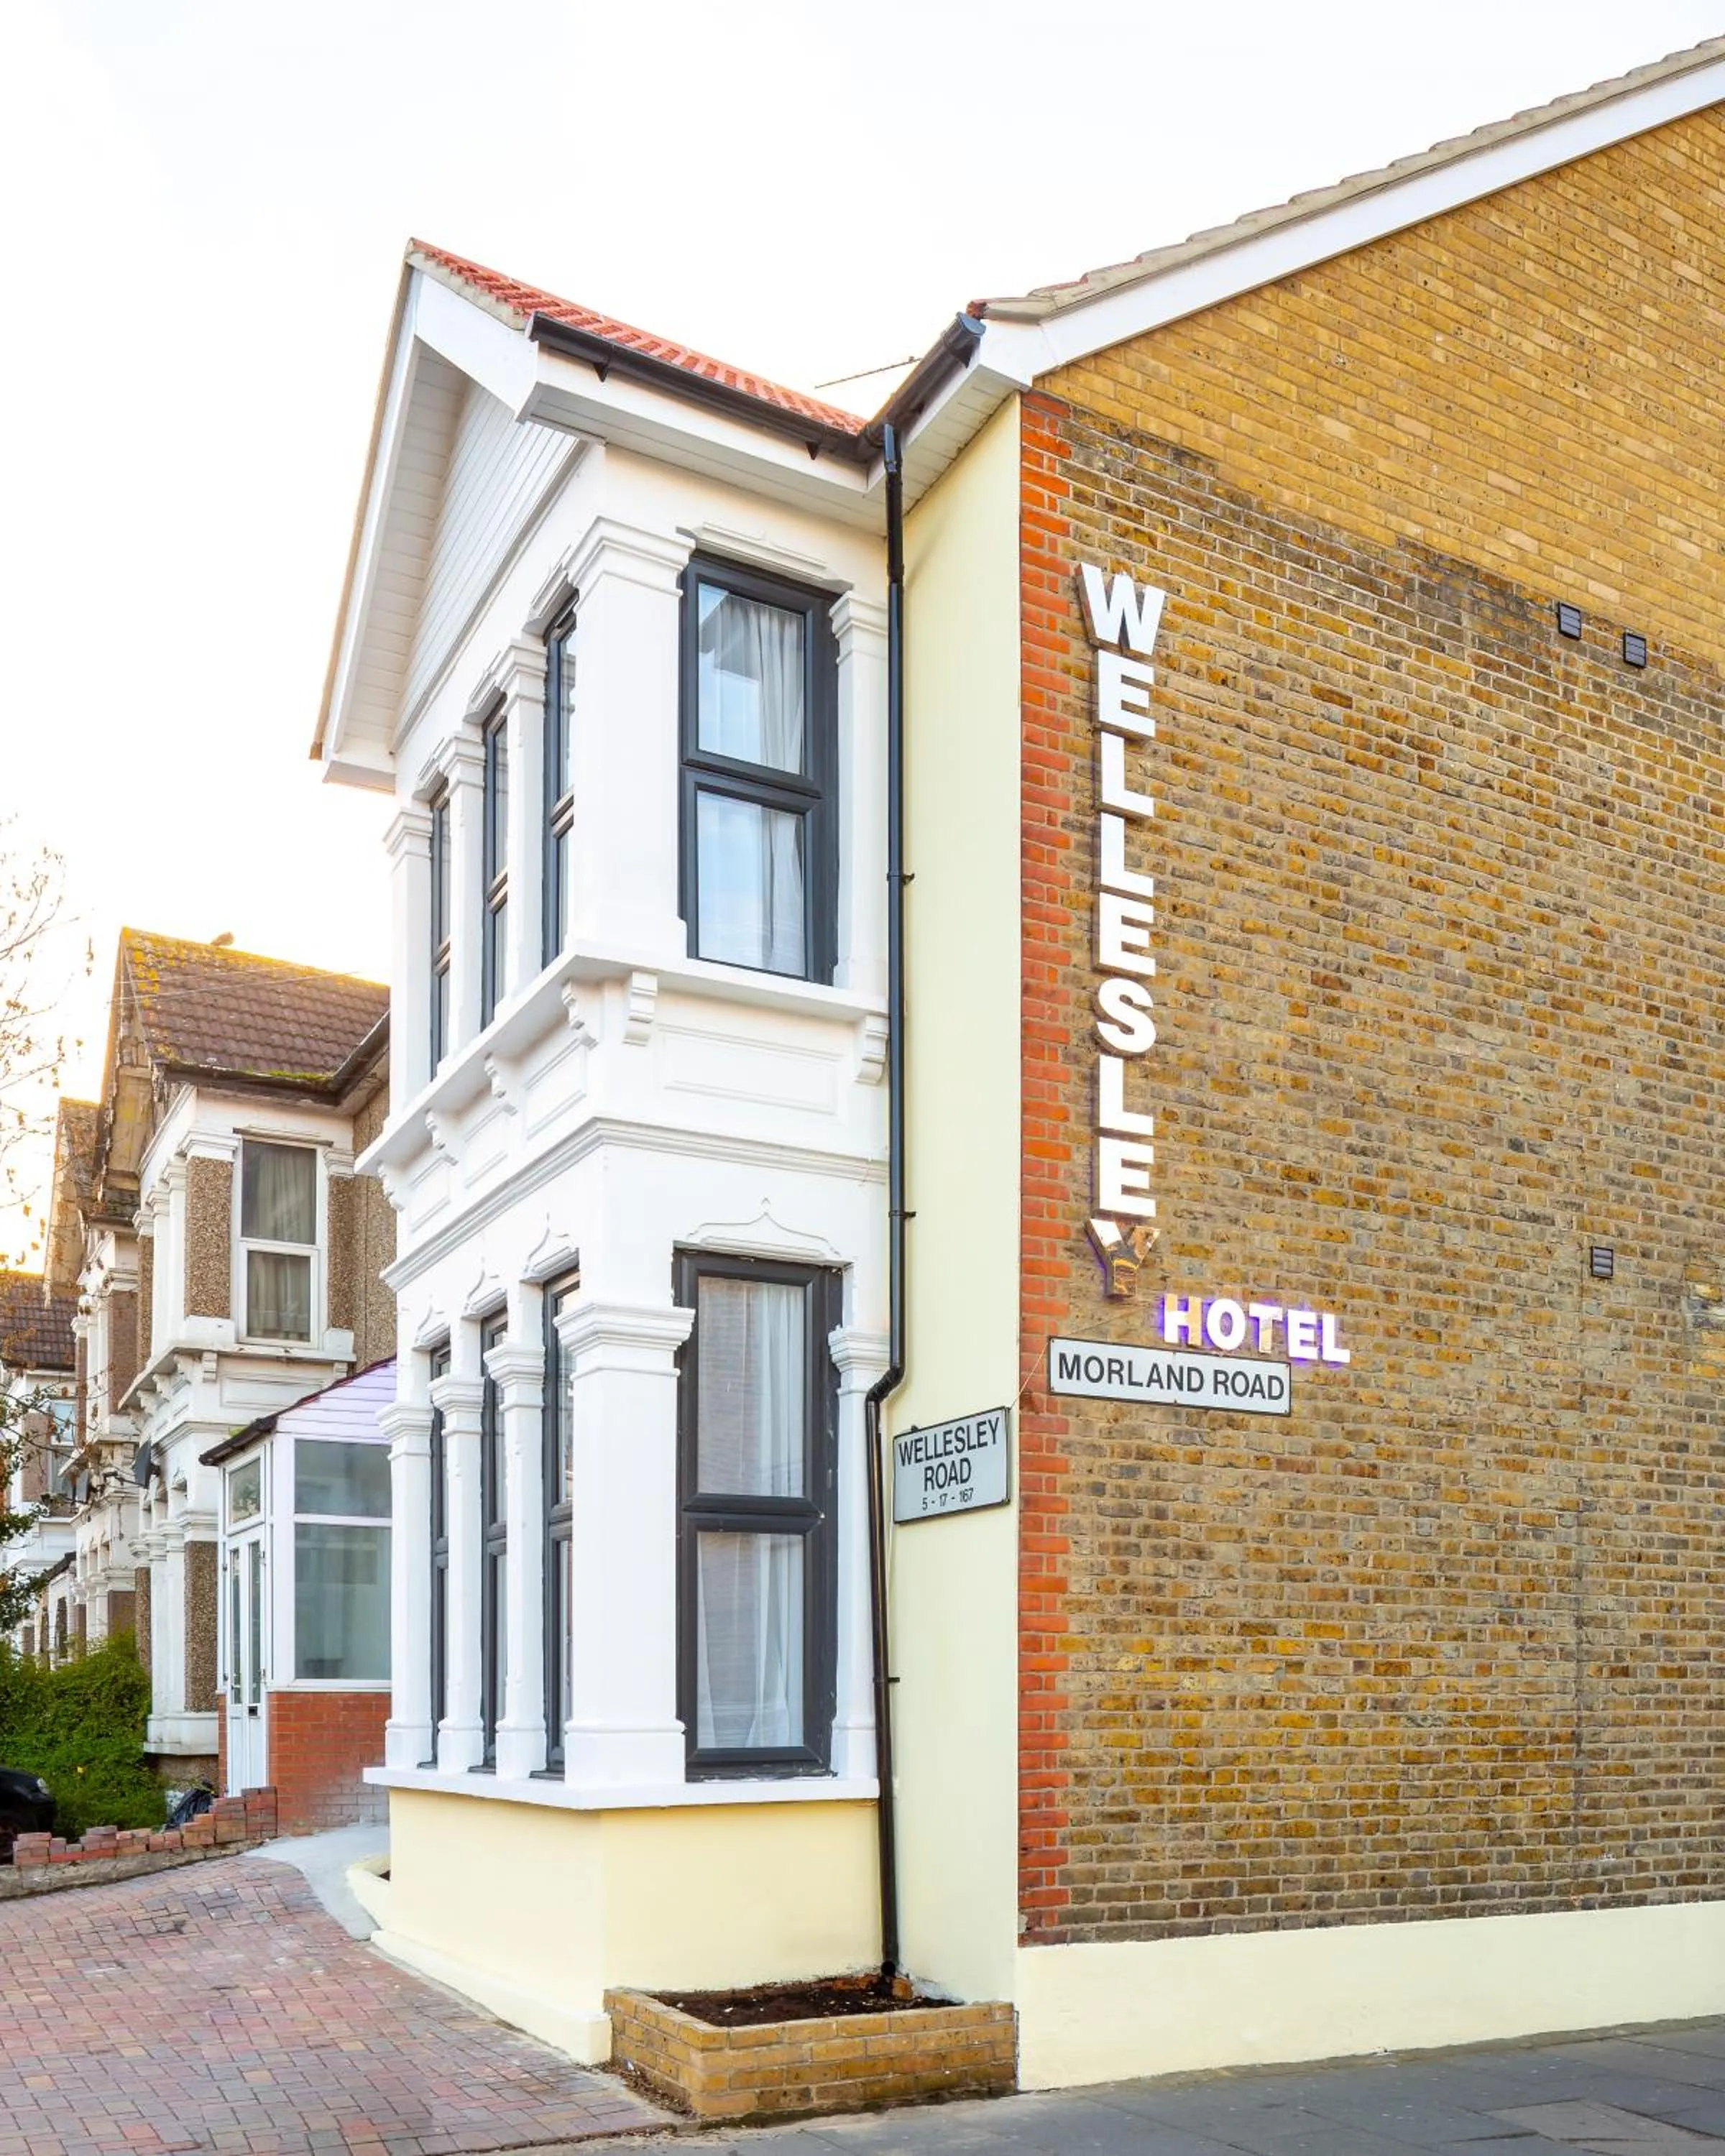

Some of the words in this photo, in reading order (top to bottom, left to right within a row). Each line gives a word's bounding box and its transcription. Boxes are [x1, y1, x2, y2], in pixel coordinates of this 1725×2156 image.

[1078, 561, 1166, 1296] WELLESLEY
[1164, 1293, 1351, 1363] HOTEL
[1058, 1352, 1205, 1393] MORLAND
[1213, 1369, 1285, 1401] ROAD
[898, 1417, 999, 1467] WELLESLEY
[924, 1457, 972, 1492] ROAD
